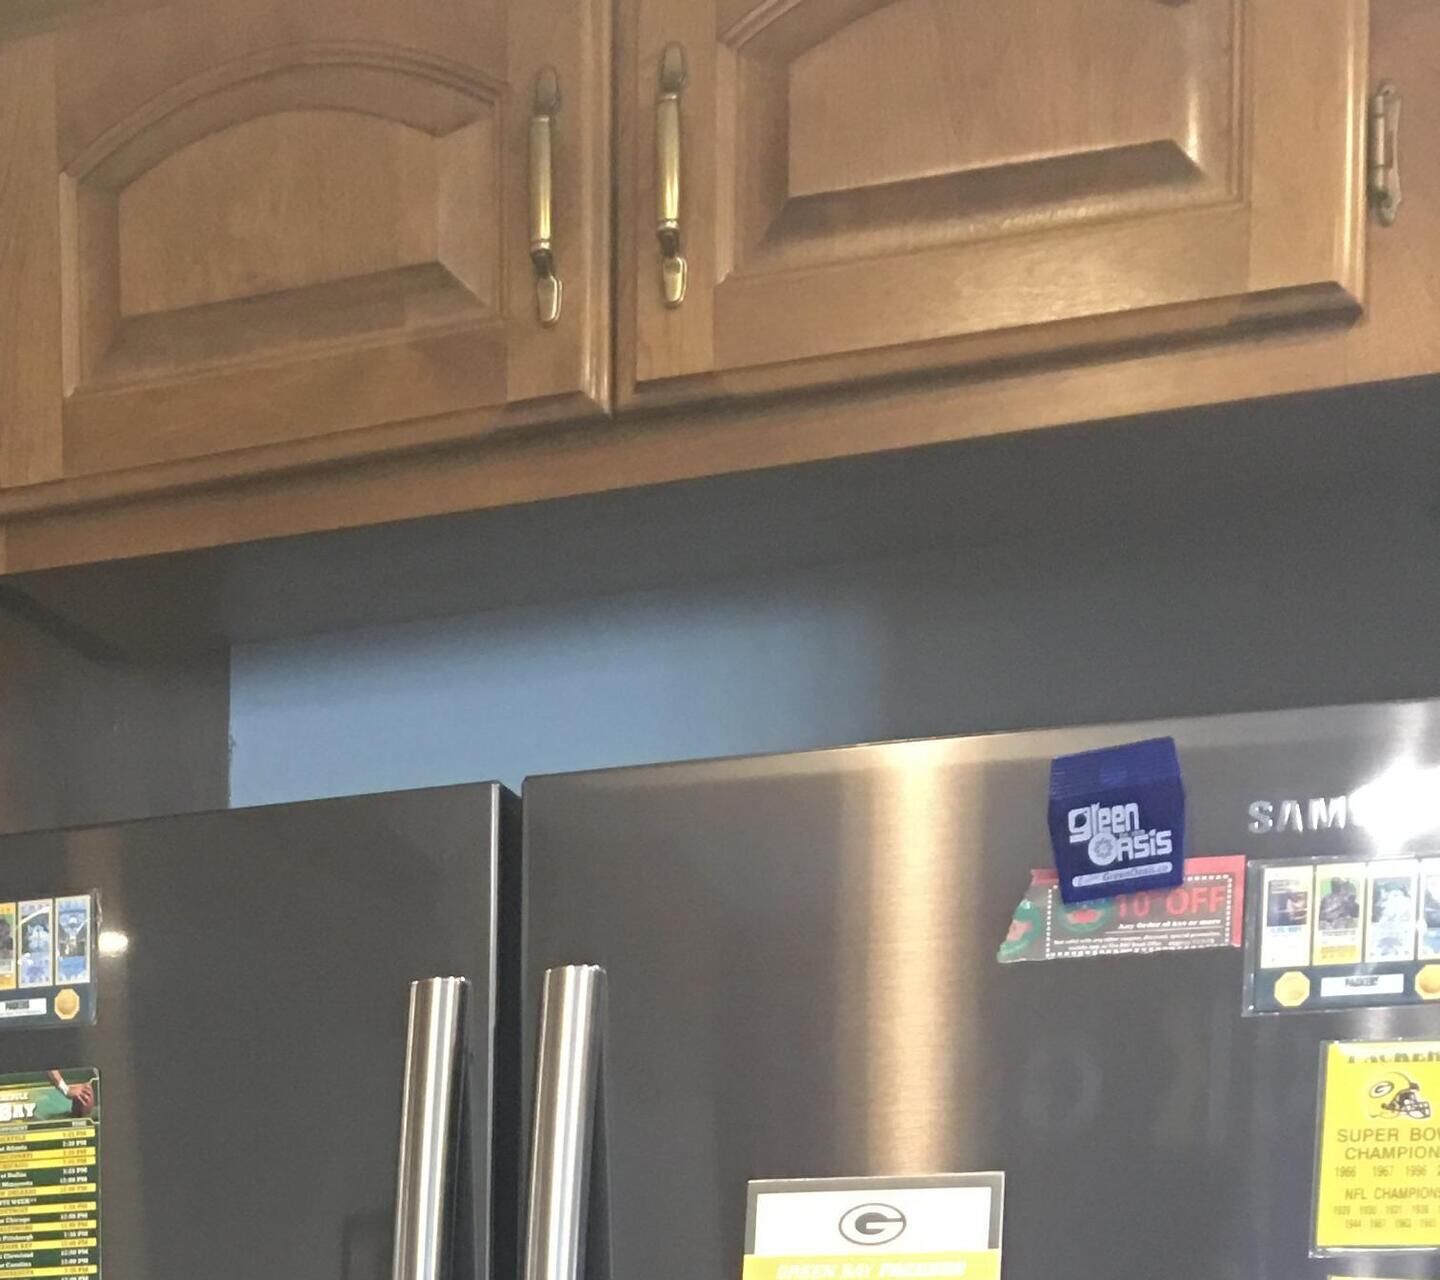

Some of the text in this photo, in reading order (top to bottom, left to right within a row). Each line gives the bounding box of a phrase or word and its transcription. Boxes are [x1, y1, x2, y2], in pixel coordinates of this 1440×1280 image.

[1166, 886, 1226, 915] OFF
[1336, 1127, 1440, 1143] SUPER BO
[1344, 1146, 1440, 1160] CHAMPION
[1344, 1188, 1367, 1200] NFL
